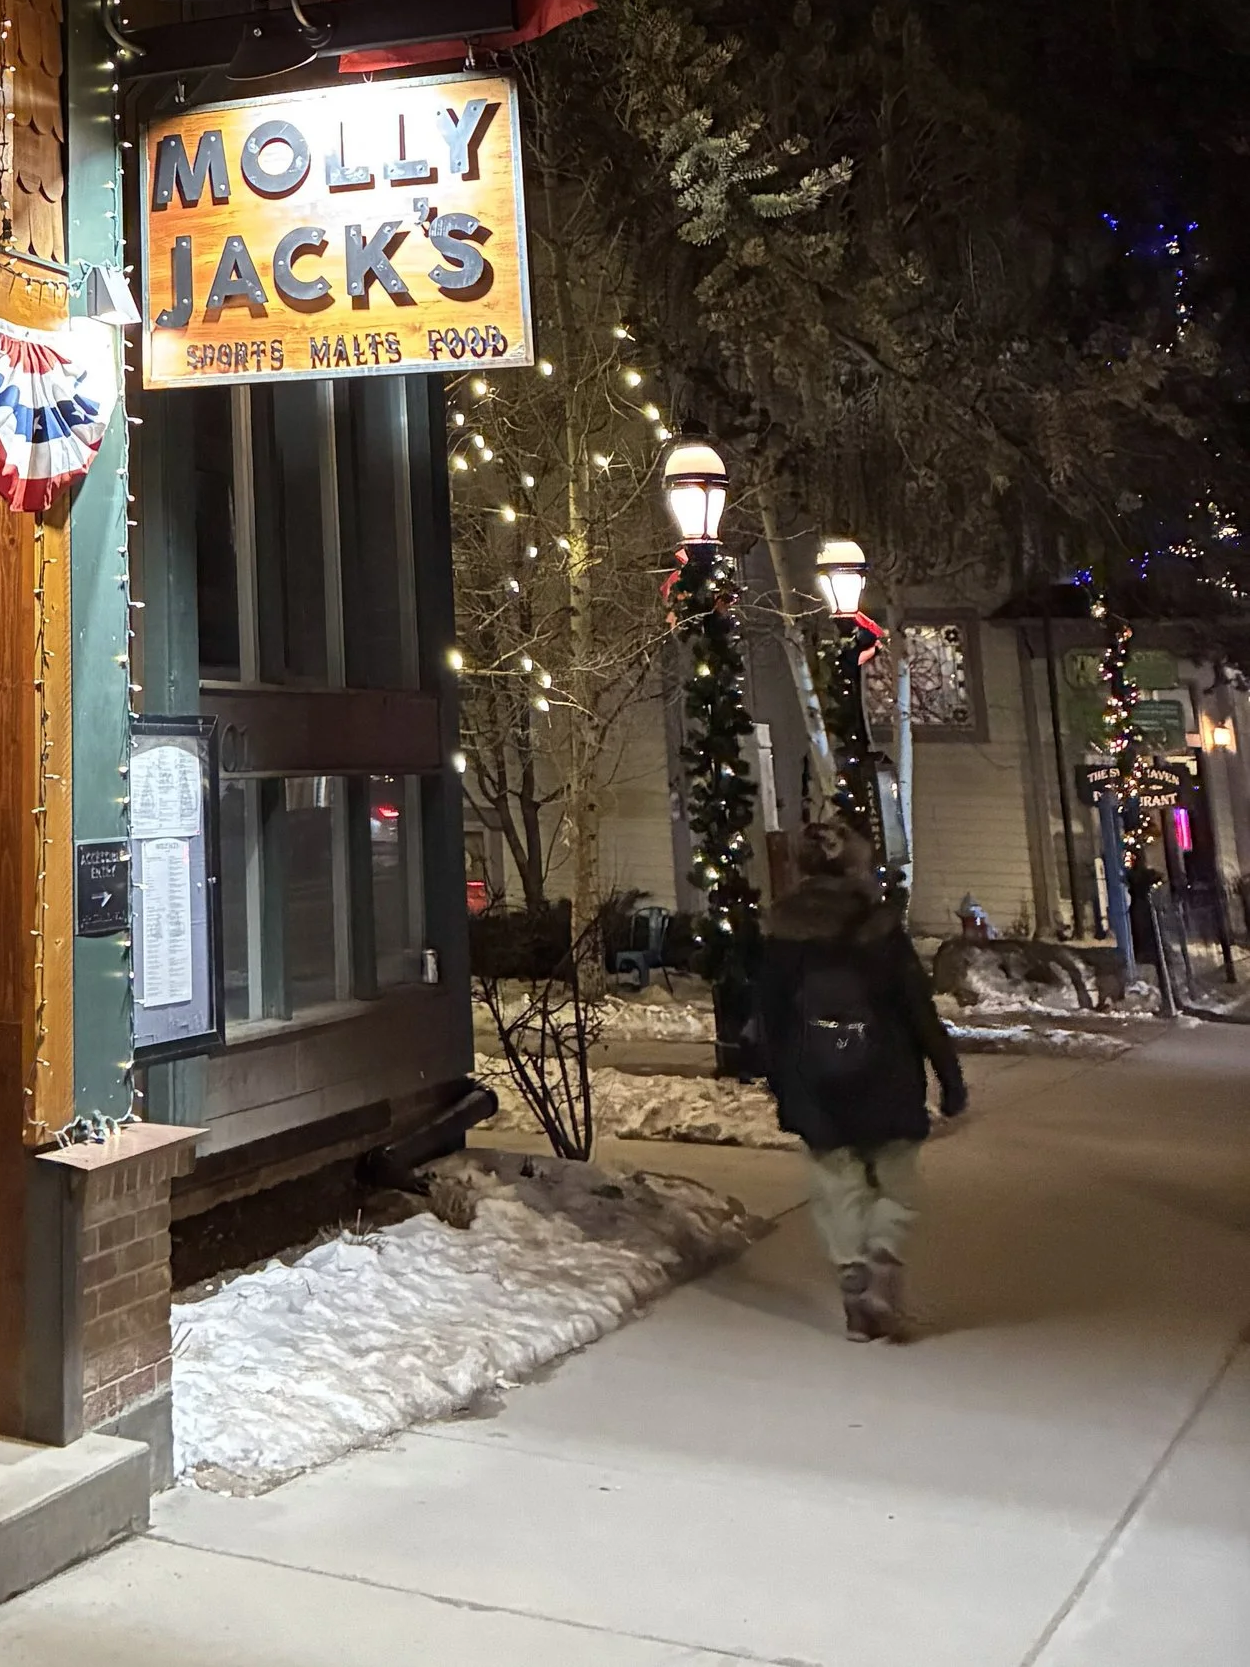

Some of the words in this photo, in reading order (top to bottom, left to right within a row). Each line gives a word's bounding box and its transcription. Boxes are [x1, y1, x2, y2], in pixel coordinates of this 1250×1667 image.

[152, 98, 501, 210] MOLLY
[155, 197, 494, 328] JACK'S
[186, 339, 284, 373] SPORTS
[310, 332, 402, 369] MALTS
[428, 325, 509, 361] FOOD
[1087, 768, 1109, 783] THE
